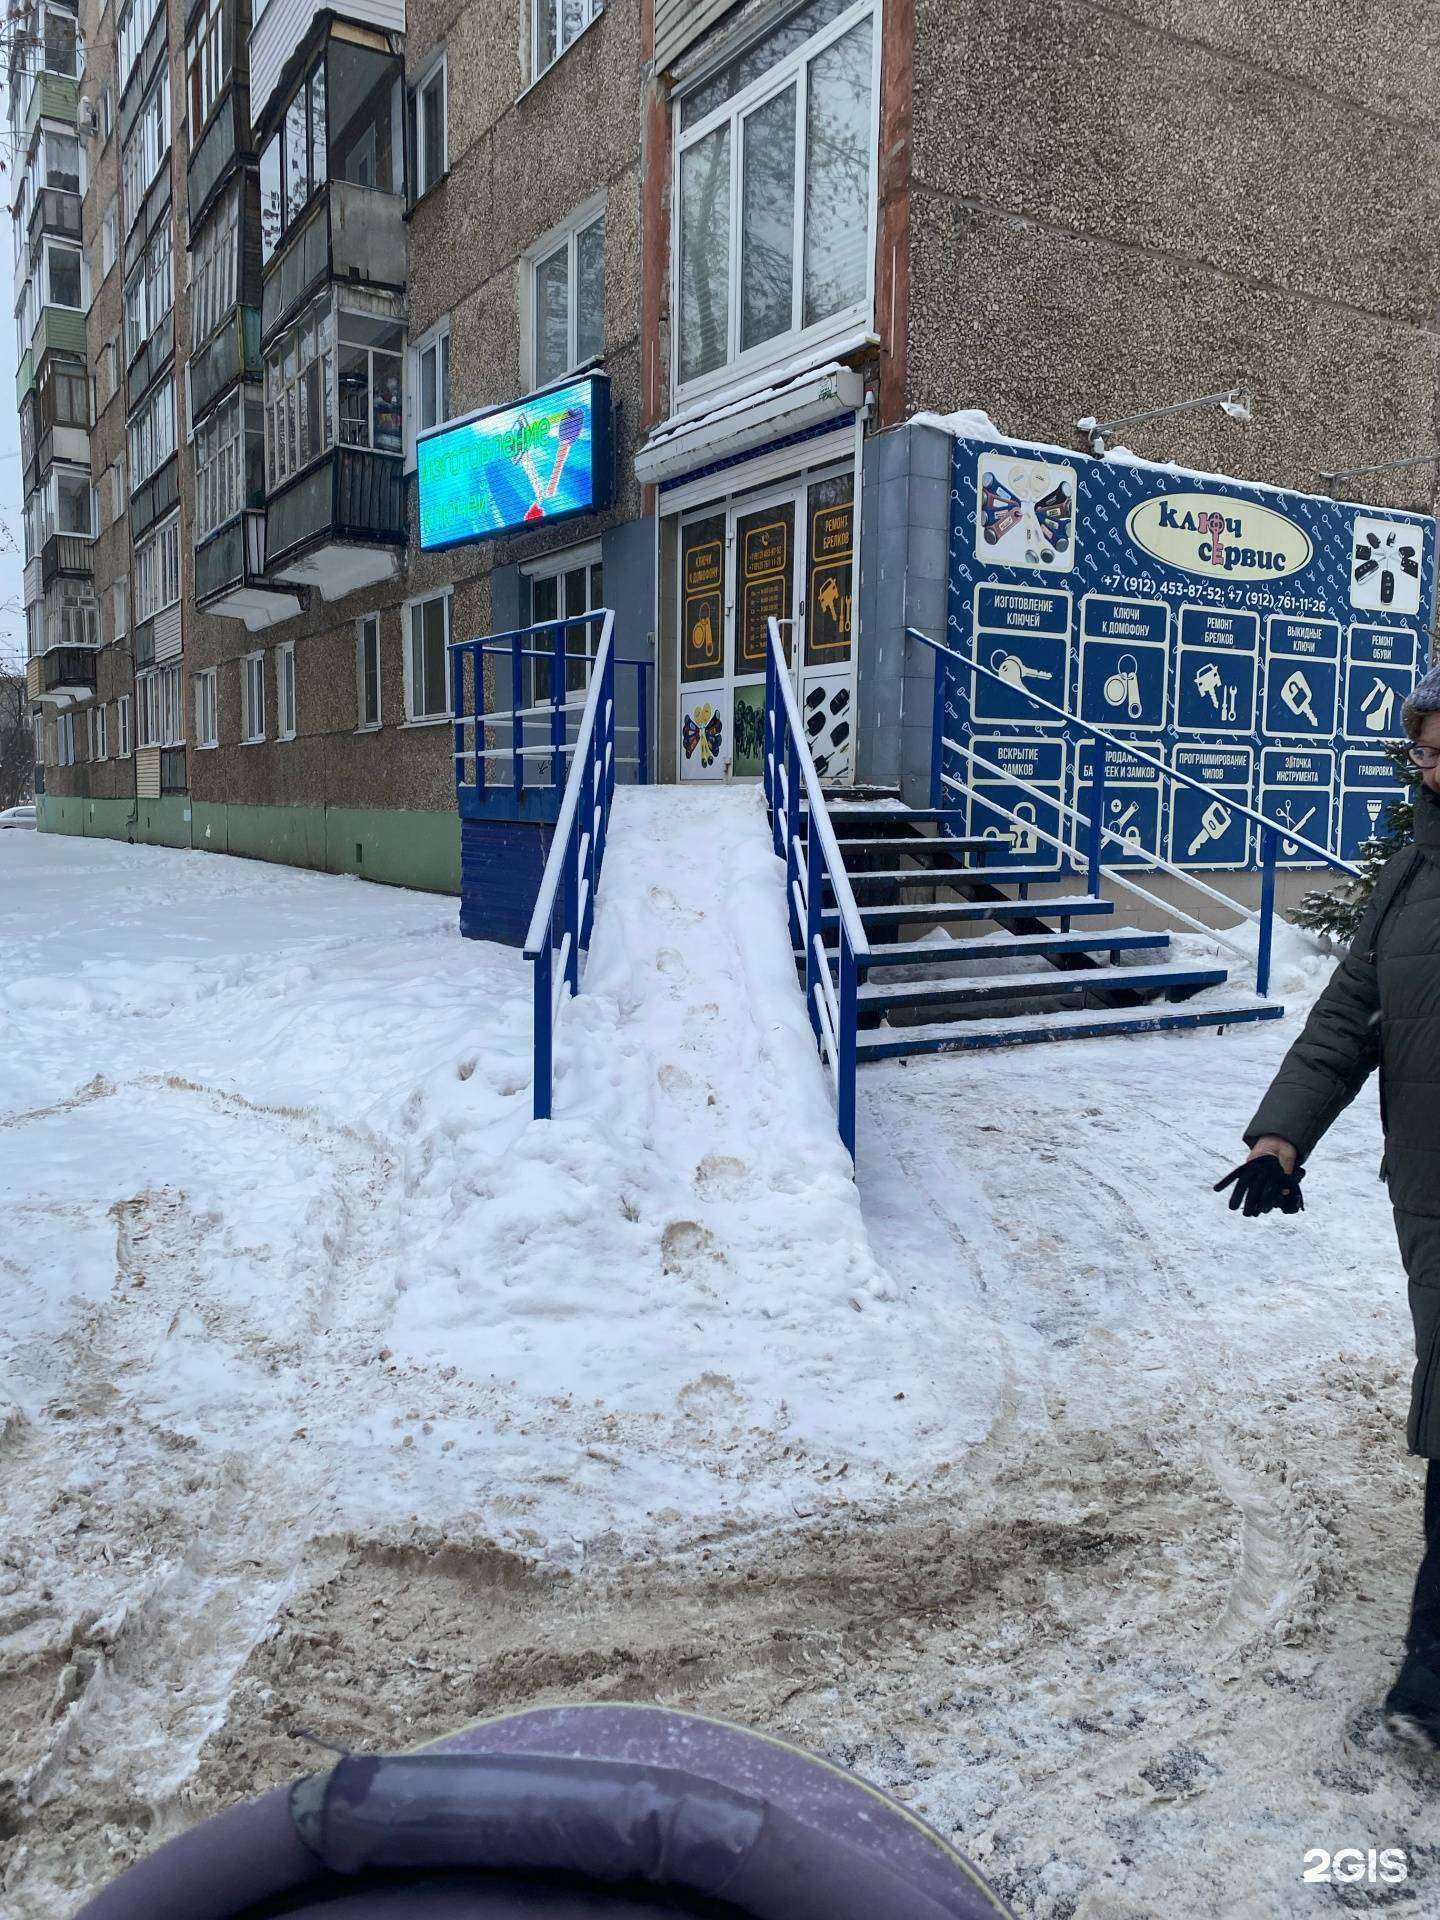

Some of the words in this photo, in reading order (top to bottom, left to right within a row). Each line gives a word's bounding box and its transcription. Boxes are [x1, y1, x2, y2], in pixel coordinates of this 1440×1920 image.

[1124, 578, 1156, 593] (912)
[1228, 590, 1243, 602] +7
[1246, 593, 1275, 607] (912)
[1277, 596, 1326, 612] 761-11-26
[994, 595, 1054, 612] ИЗГОТОВЛЕНИЕ
[1006, 612, 1040, 627] КЛЮЧЕЙ
[1113, 606, 1140, 620] КЛЮЧИ
[1102, 621, 1107, 632] К
[1108, 623, 1150, 636] ДОМОФОНУ
[1206, 617, 1232, 630] РЕМОНТ
[1204, 631, 1234, 645] БРЕЛКОВ
[1287, 625, 1322, 639] ВЫКИДНЫЕ
[1293, 641, 1316, 653] КЛЮЧИ
[1371, 635, 1394, 647] РЕМОНТ
[1372, 649, 1392, 660] ОБУВИ
[997, 747, 1039, 760] ВСКРЫТИЕ
[1179, 752, 1247, 766] ПРОГРАММИРОВАНИЕ
[1002, 763, 1034, 776] ЗАМКОВ
[1120, 766, 1126, 777] И
[1126, 766, 1155, 778] ЗАМКОВ
[1276, 770, 1319, 782] ИНСТРУМЕНТА
[1358, 765, 1394, 776] ГРАВИРОВКА
